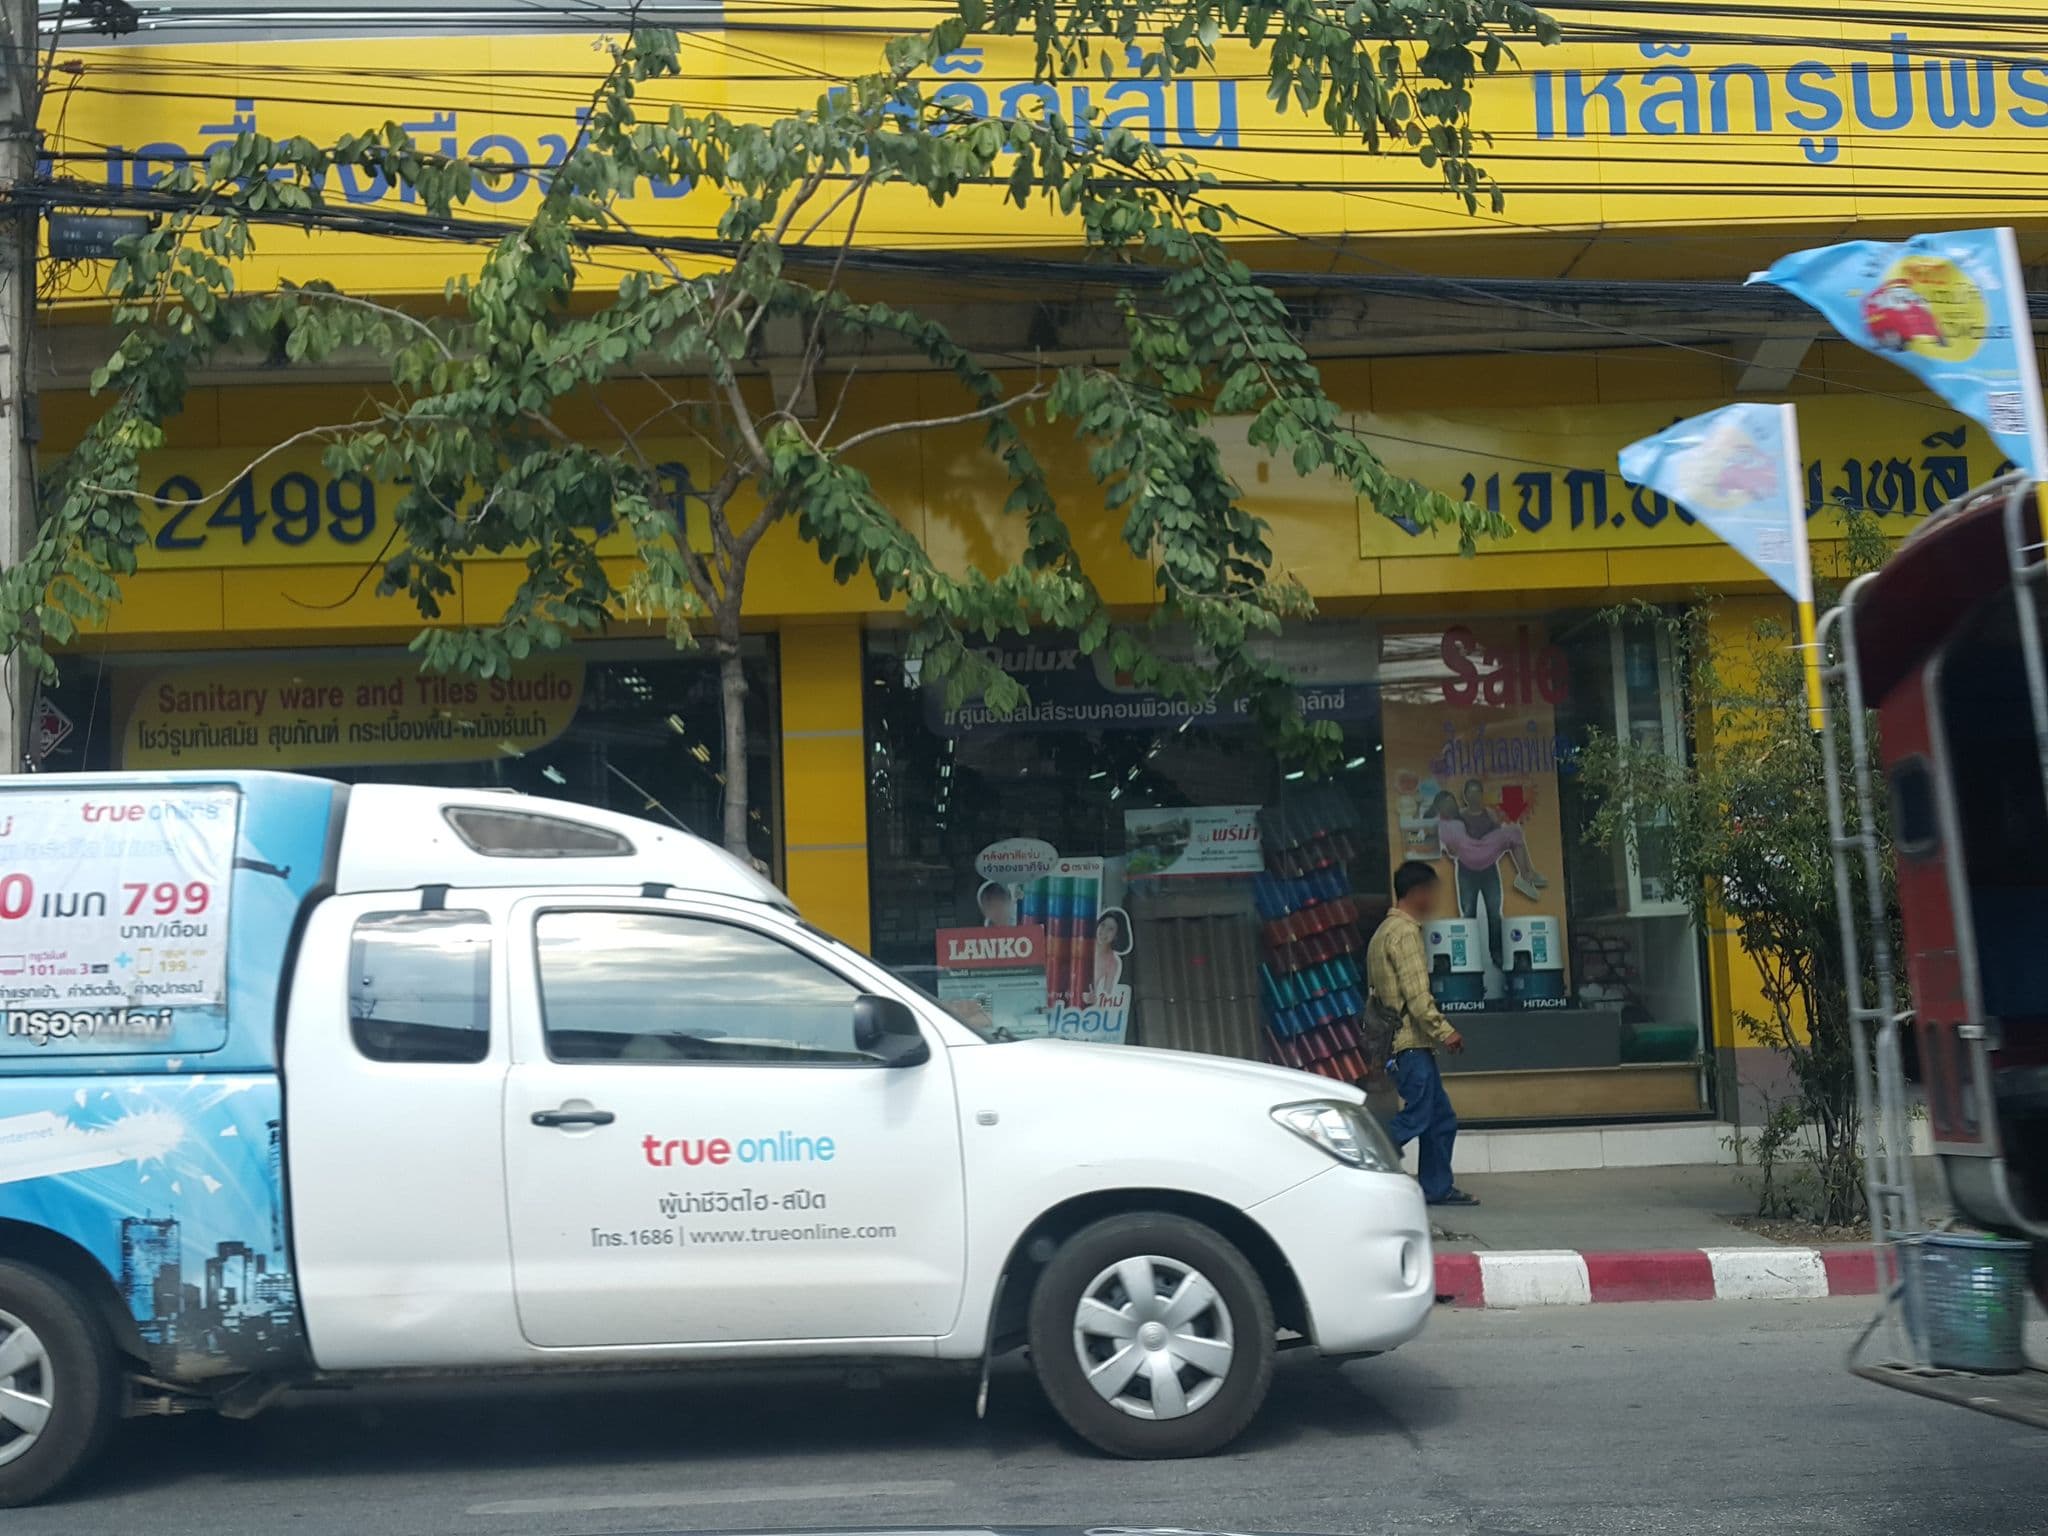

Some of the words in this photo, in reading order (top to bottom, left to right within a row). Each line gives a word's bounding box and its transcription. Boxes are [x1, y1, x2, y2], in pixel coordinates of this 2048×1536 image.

[828, 46, 1239, 156] ล็กเส้น
[1440, 624, 1570, 706] Sale
[158, 684, 267, 716] Sanitary
[279, 685, 344, 709] ware
[356, 679, 404, 707] and
[416, 676, 479, 705] Tiles
[489, 672, 573, 703] Studio
[138, 719, 258, 756] โชว์รูมทันสมัย
[269, 716, 340, 753] สุขภัณฑ์
[82, 801, 145, 823] true
[40, 890, 107, 919] เมก
[122, 881, 210, 916] 799
[120, 919, 209, 939] บาท/เดือน
[948, 937, 1033, 960] LANKO
[28, 963, 56, 976] 101
[1441, 1001, 1486, 1011] HITACHI
[1524, 998, 1567, 1009] HITACHI
[641, 1134, 732, 1166] true
[737, 1130, 836, 1163] online
[590, 1227, 674, 1248] โทร.1686
[689, 1223, 897, 1244] www.trueonline.com
